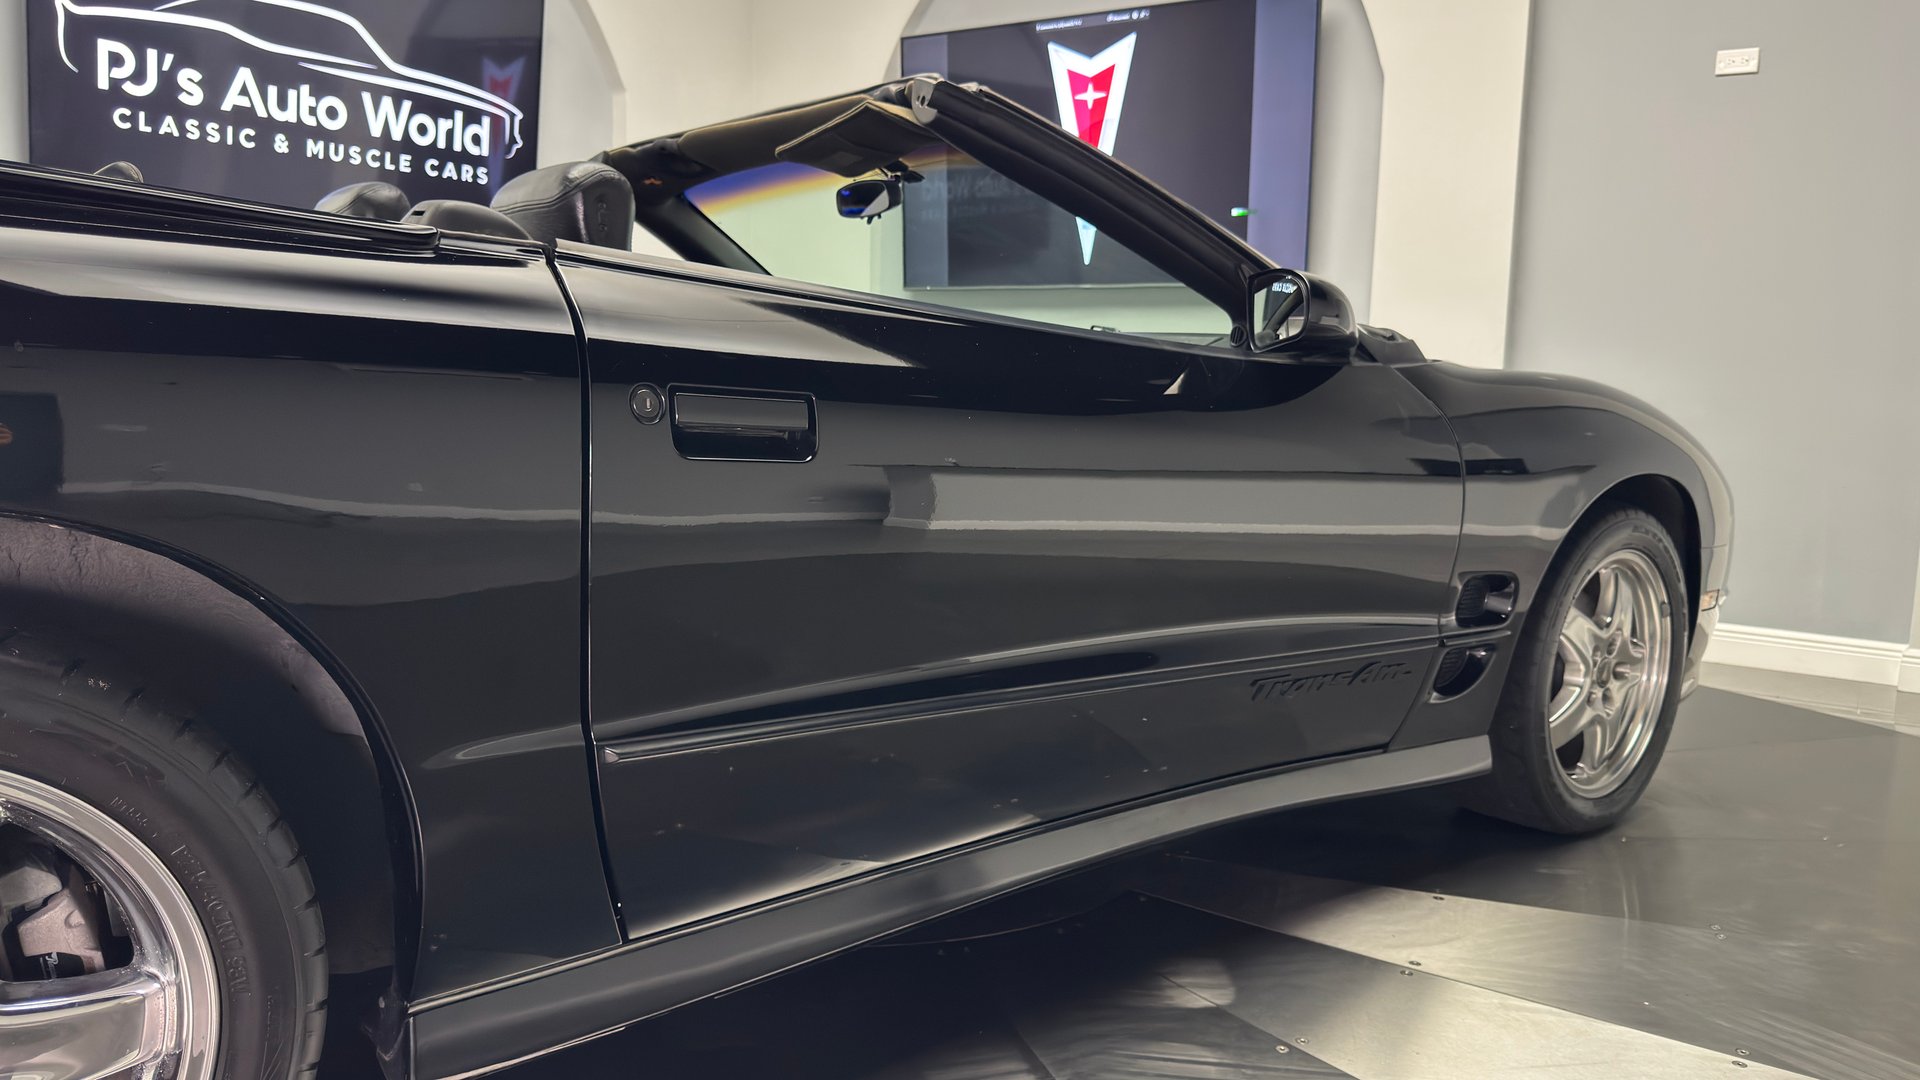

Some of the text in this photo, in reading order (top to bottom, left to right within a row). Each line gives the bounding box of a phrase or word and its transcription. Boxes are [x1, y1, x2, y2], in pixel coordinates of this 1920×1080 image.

[96, 37, 491, 157] PJ's Auto World
[112, 107, 489, 185] CLASSIC & MUSCLE CARS
